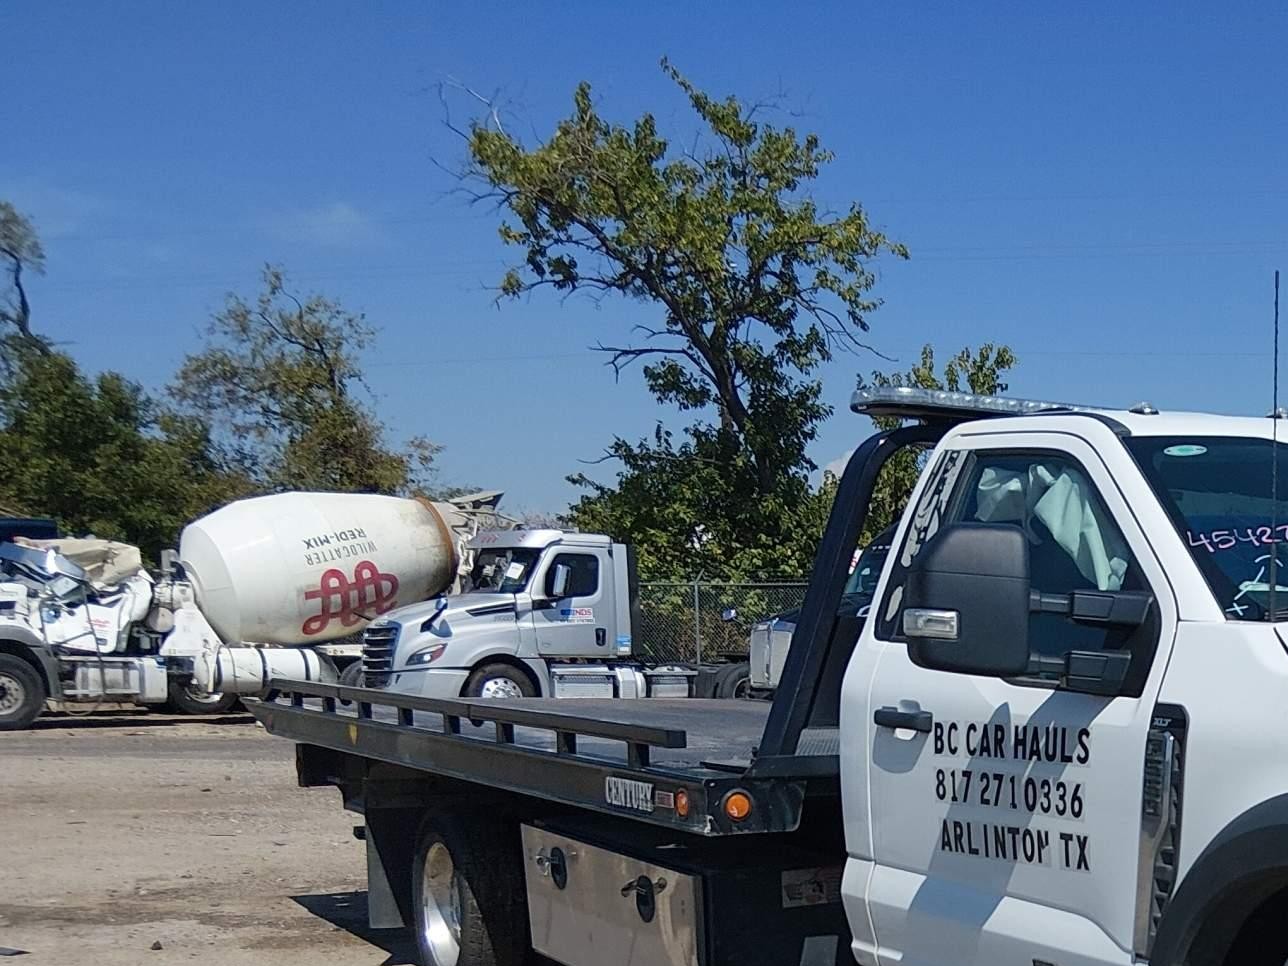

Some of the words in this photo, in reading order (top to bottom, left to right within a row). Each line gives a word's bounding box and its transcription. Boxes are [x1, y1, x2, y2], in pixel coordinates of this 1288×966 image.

[302, 527, 368, 550] REDI-MIX
[304, 540, 377, 566] WILDCATTER
[1152, 717, 1172, 726] XLT
[934, 721, 959, 755] BC
[966, 722, 1006, 759] CAR
[1013, 724, 1090, 764] HAULS
[605, 775, 655, 812] CENTURY
[936, 768, 972, 803] 817
[941, 818, 1049, 864] ARLINTON
[1059, 832, 1090, 871] TX
